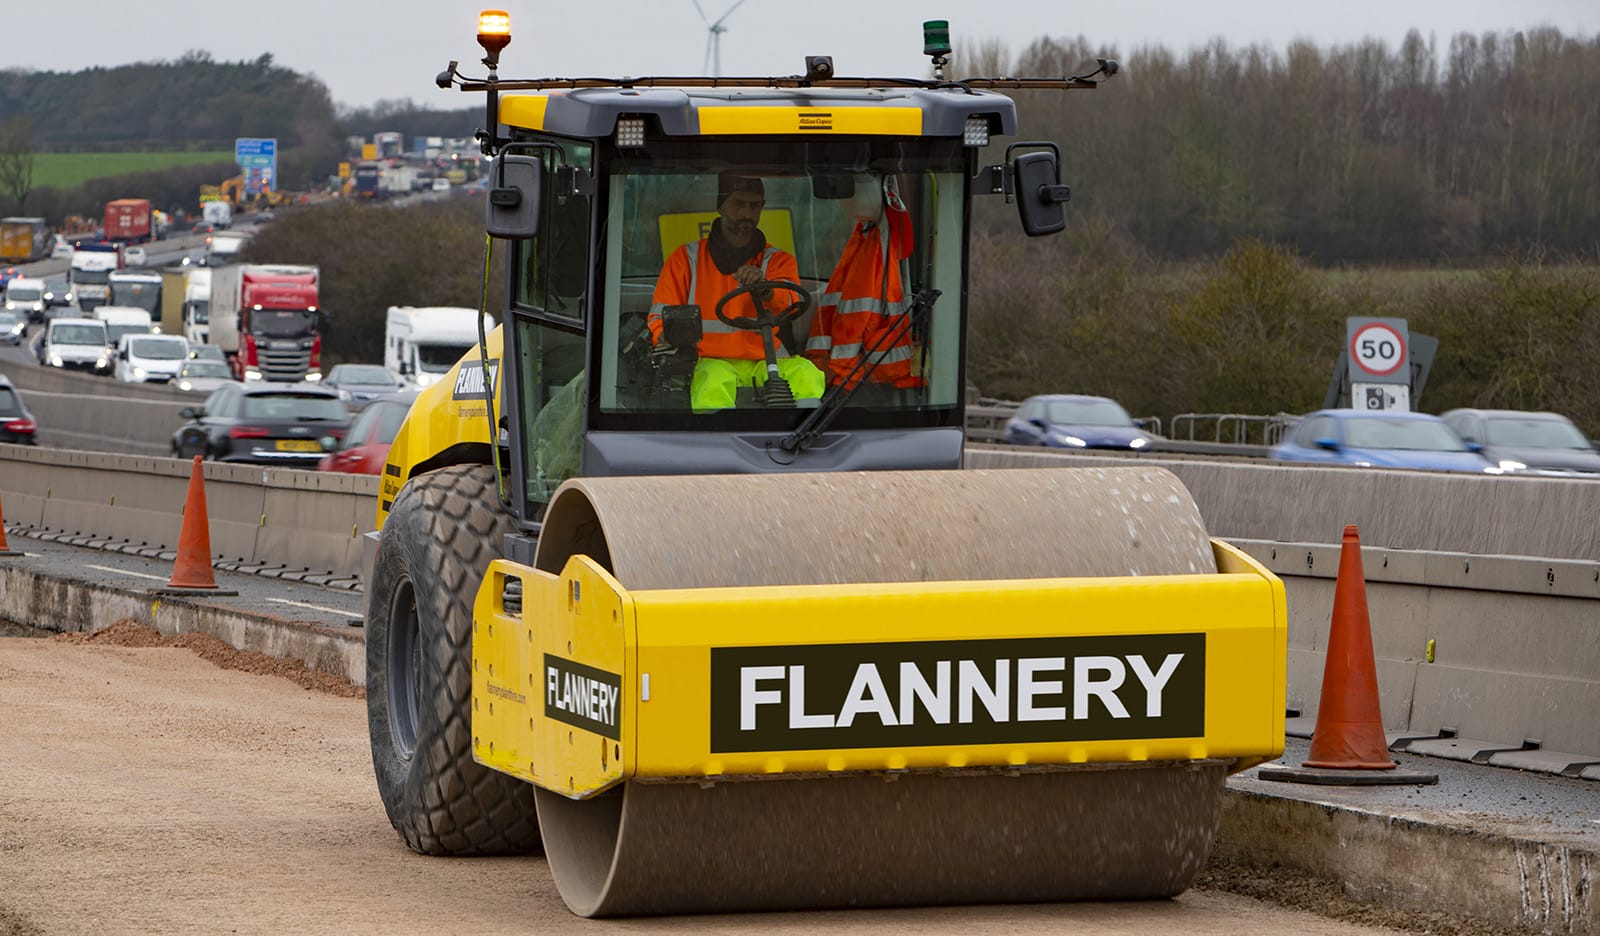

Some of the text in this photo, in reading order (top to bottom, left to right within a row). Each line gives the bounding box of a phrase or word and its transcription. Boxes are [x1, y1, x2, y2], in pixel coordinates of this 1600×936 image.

[1362, 340, 1395, 360] 50
[547, 666, 619, 726] FLANNERY
[740, 653, 1185, 731] FLANNERY
